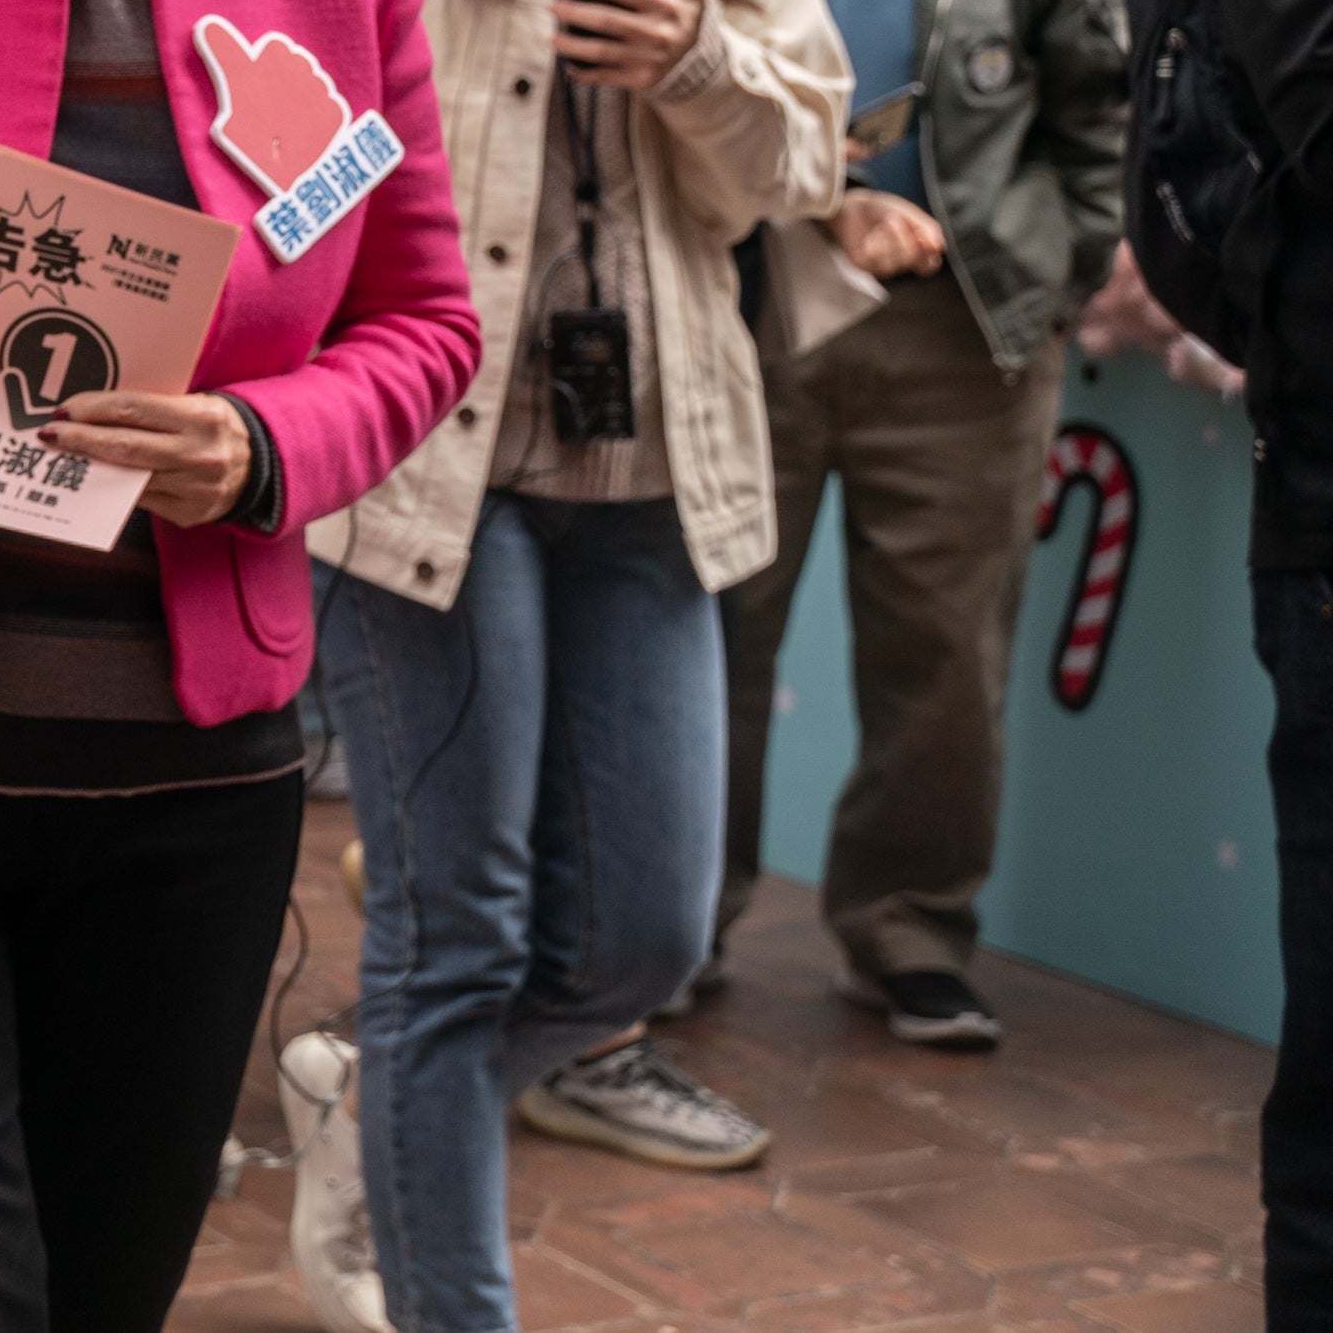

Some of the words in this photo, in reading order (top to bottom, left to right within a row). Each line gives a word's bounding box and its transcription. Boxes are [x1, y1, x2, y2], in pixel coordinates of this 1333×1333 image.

[266, 120, 397, 253] 葉劉淑儀
[39, 331, 78, 402] 1
